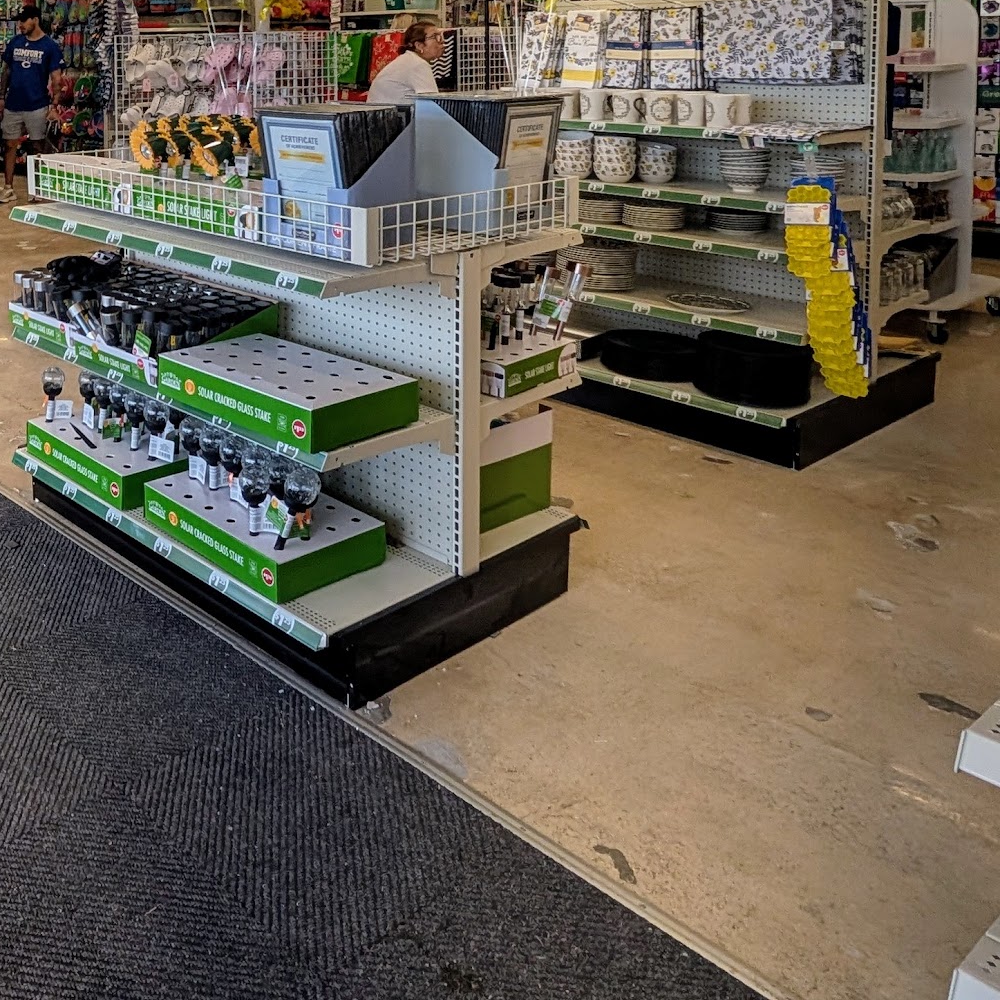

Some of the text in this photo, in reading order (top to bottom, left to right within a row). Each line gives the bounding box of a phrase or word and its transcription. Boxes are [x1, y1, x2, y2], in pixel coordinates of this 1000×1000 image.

[281, 135, 318, 146] CERTIFICATE
[517, 124, 544, 134] CERTIFICATE
[198, 386, 271, 423] SOLAR CRACKED GLASS STAKE
[53, 448, 62, 461] SOLAR
[63, 455, 76, 470] CRACKED
[77, 463, 87, 476] GLASS
[180, 519, 244, 567] SOLAR CRACKED GLASS STAKE
